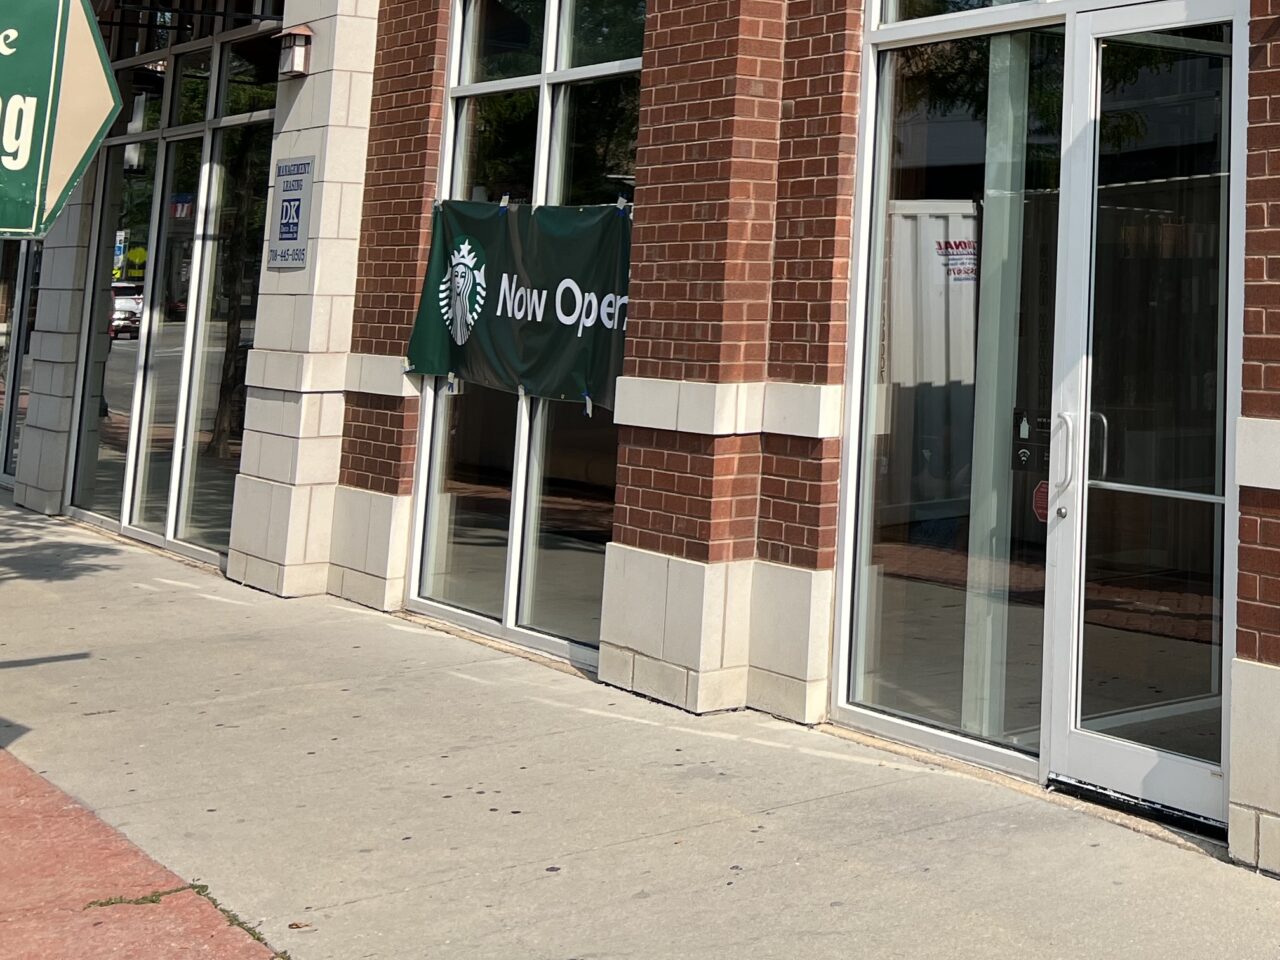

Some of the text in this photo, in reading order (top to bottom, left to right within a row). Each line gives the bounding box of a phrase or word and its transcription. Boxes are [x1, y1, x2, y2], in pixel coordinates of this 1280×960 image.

[277, 163, 310, 177] MANAGEMENT
[282, 179, 304, 192] LEASING
[281, 201, 299, 223] DK
[496, 273, 547, 322] Now
